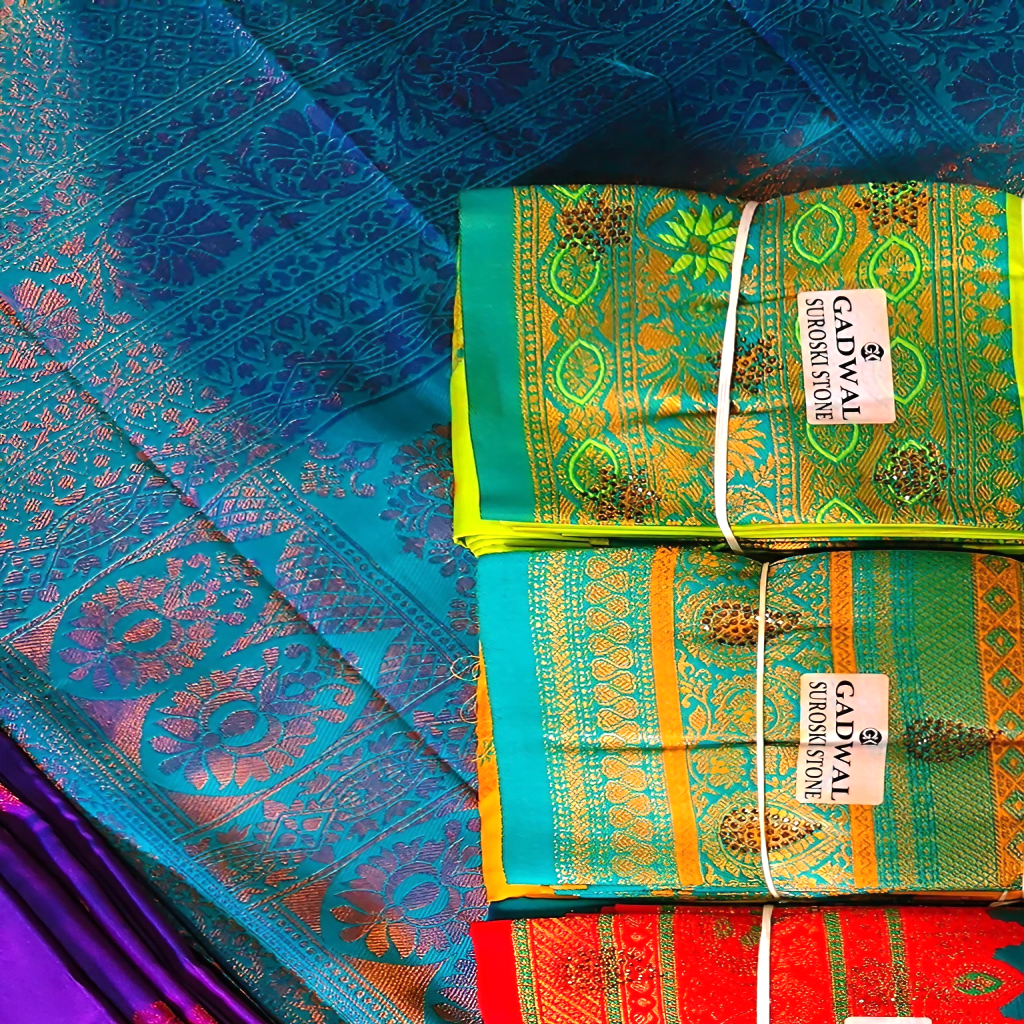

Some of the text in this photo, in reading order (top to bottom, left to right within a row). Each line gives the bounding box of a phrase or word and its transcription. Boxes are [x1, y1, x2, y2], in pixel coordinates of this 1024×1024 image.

[806, 298, 834, 421] SUROSKI STONE
[832, 295, 861, 421] GADWAL
[804, 682, 829, 800] SUROSKI STONE
[831, 679, 856, 802] GADWAL
